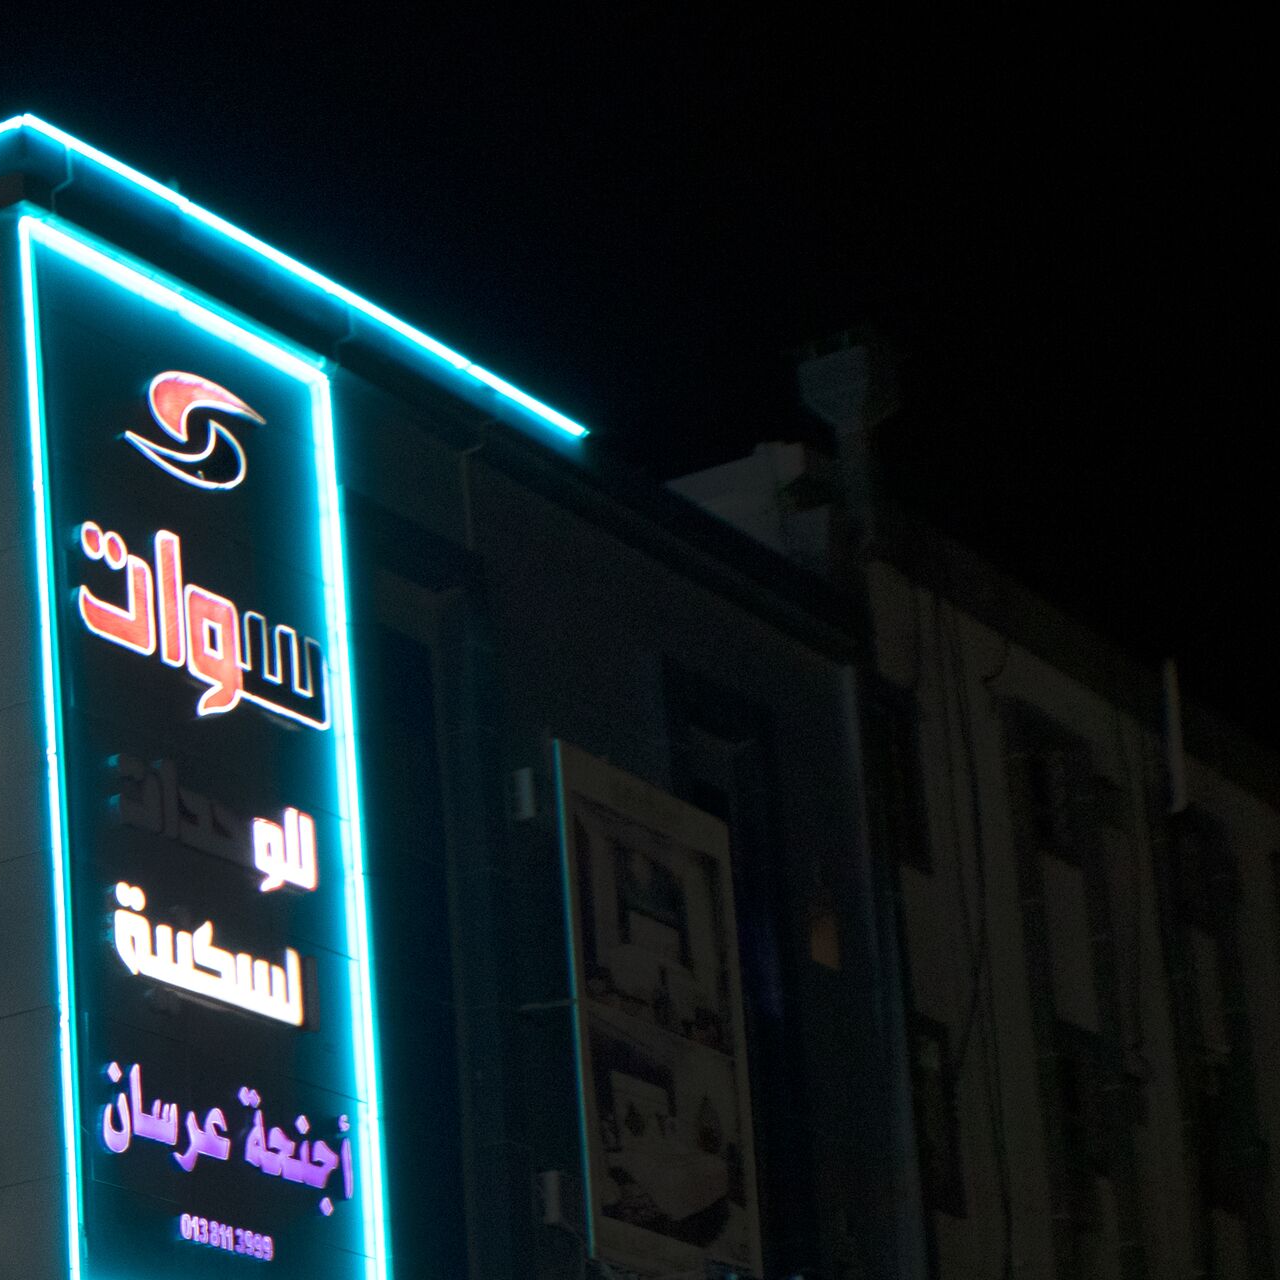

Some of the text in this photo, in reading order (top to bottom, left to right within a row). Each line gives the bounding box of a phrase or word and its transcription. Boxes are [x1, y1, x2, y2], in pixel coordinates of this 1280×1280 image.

[78, 520, 330, 731] سوات
[102, 1061, 354, 1217] أجنحة عرسان
